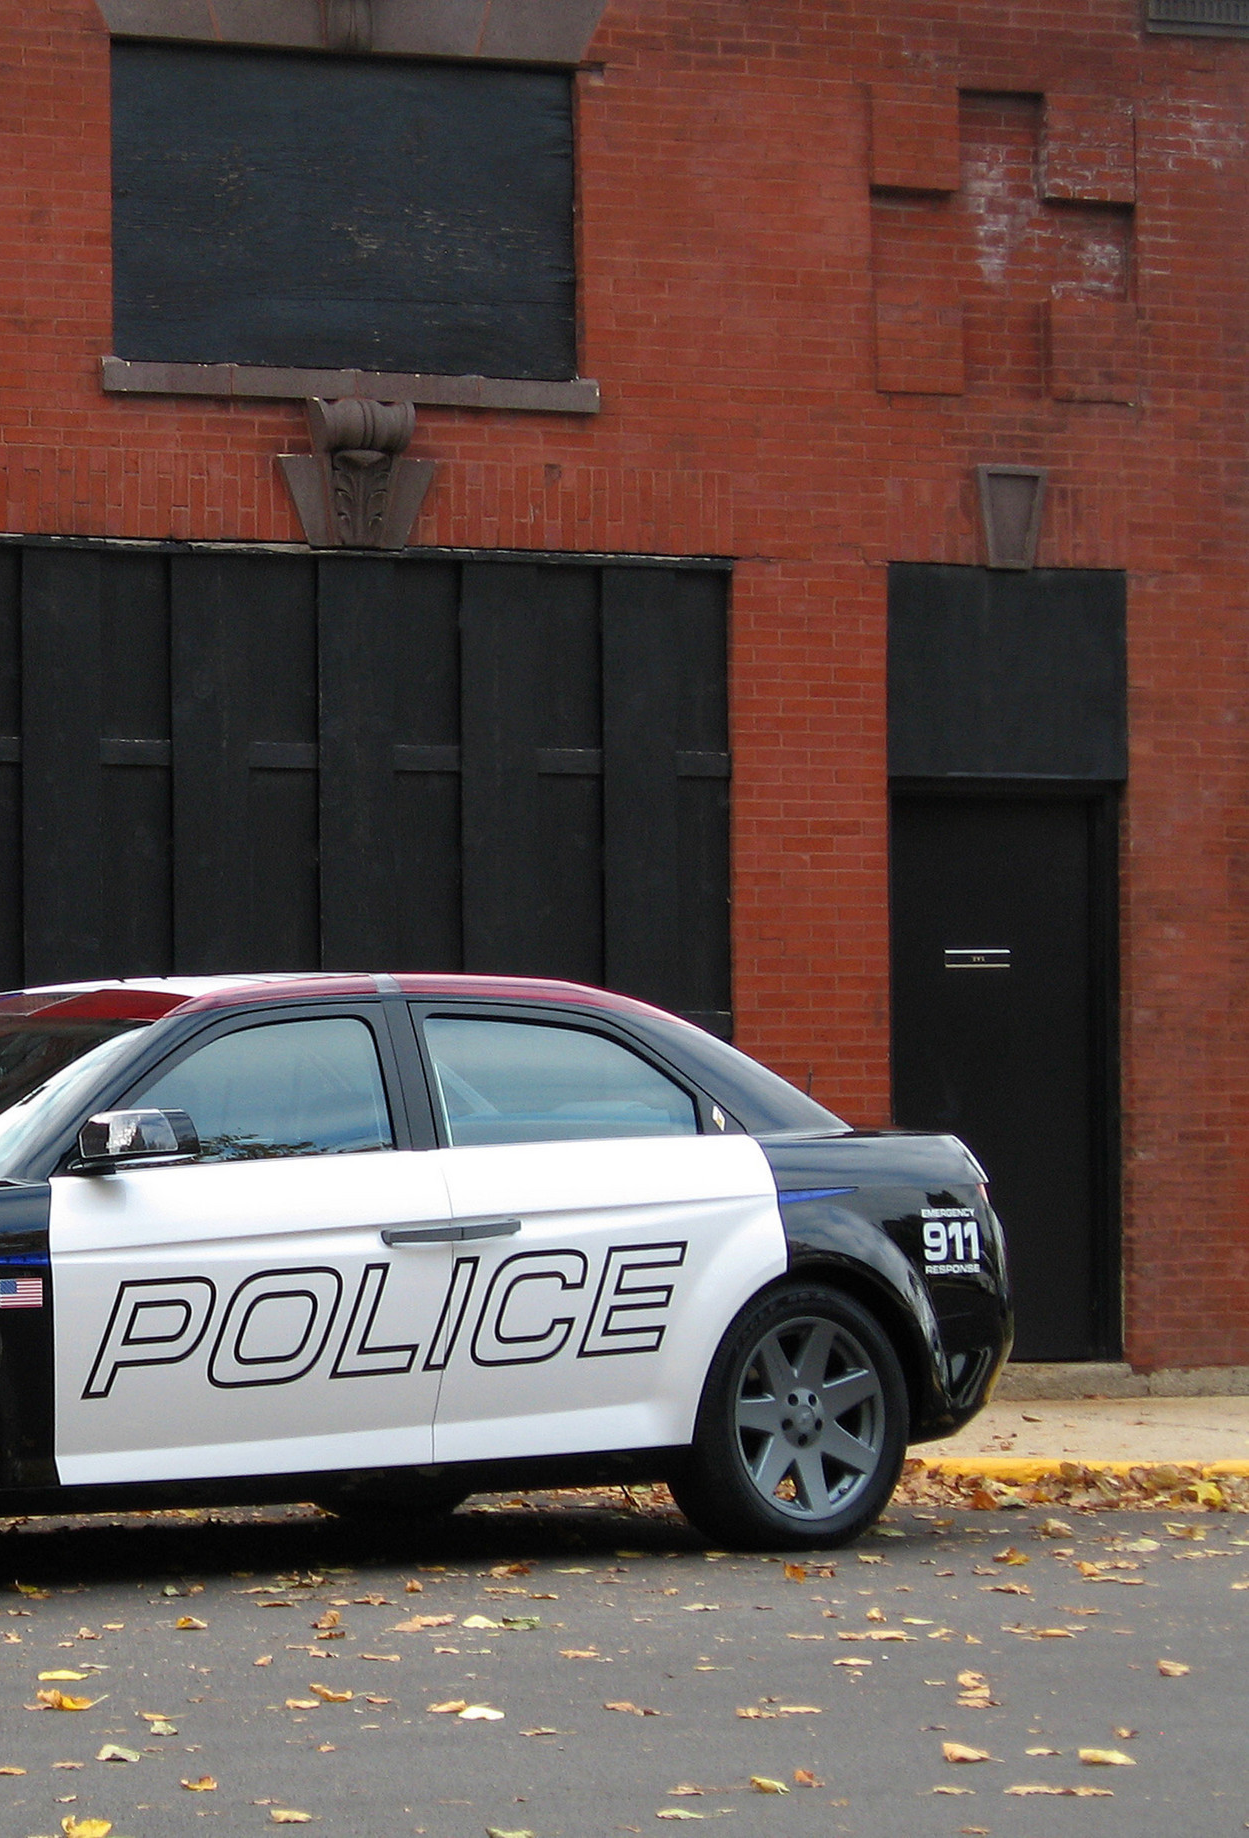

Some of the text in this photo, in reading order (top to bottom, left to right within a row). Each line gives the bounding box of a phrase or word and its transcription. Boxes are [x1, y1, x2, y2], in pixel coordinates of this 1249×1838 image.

[920, 1208, 975, 1219] EMERGENCY
[923, 1221, 980, 1262] 911
[924, 1263, 981, 1275] RESPONSE
[80, 1240, 688, 1400] POLICE
